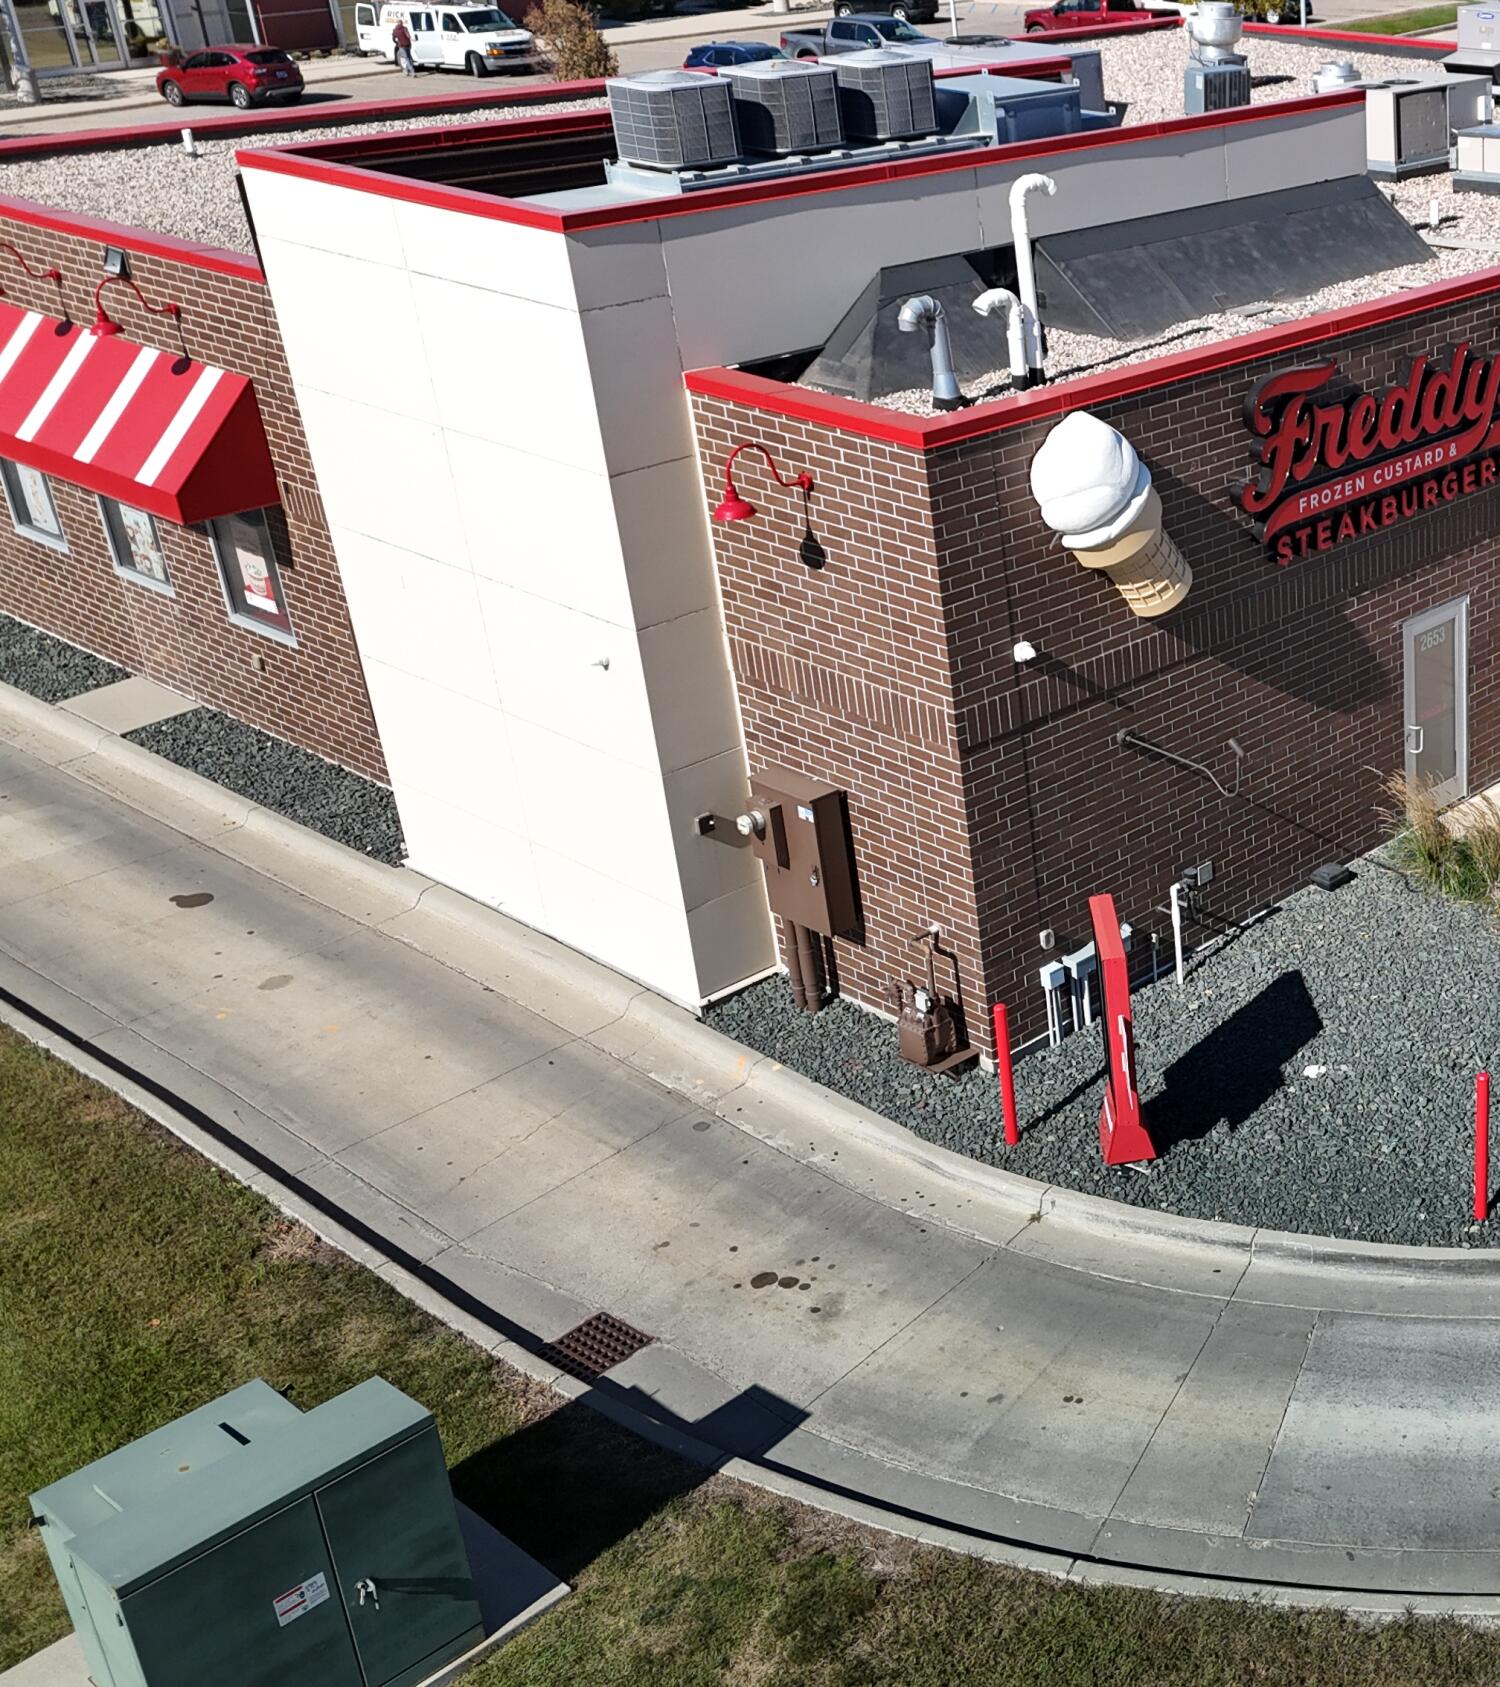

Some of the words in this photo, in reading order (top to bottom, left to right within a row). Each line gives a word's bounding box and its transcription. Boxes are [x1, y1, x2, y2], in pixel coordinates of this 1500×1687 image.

[1299, 479, 1365, 514] FROZEN
[1372, 446, 1444, 485] CUSTARD
[1448, 442, 1458, 458] &
[1420, 626, 1445, 652] 2653
